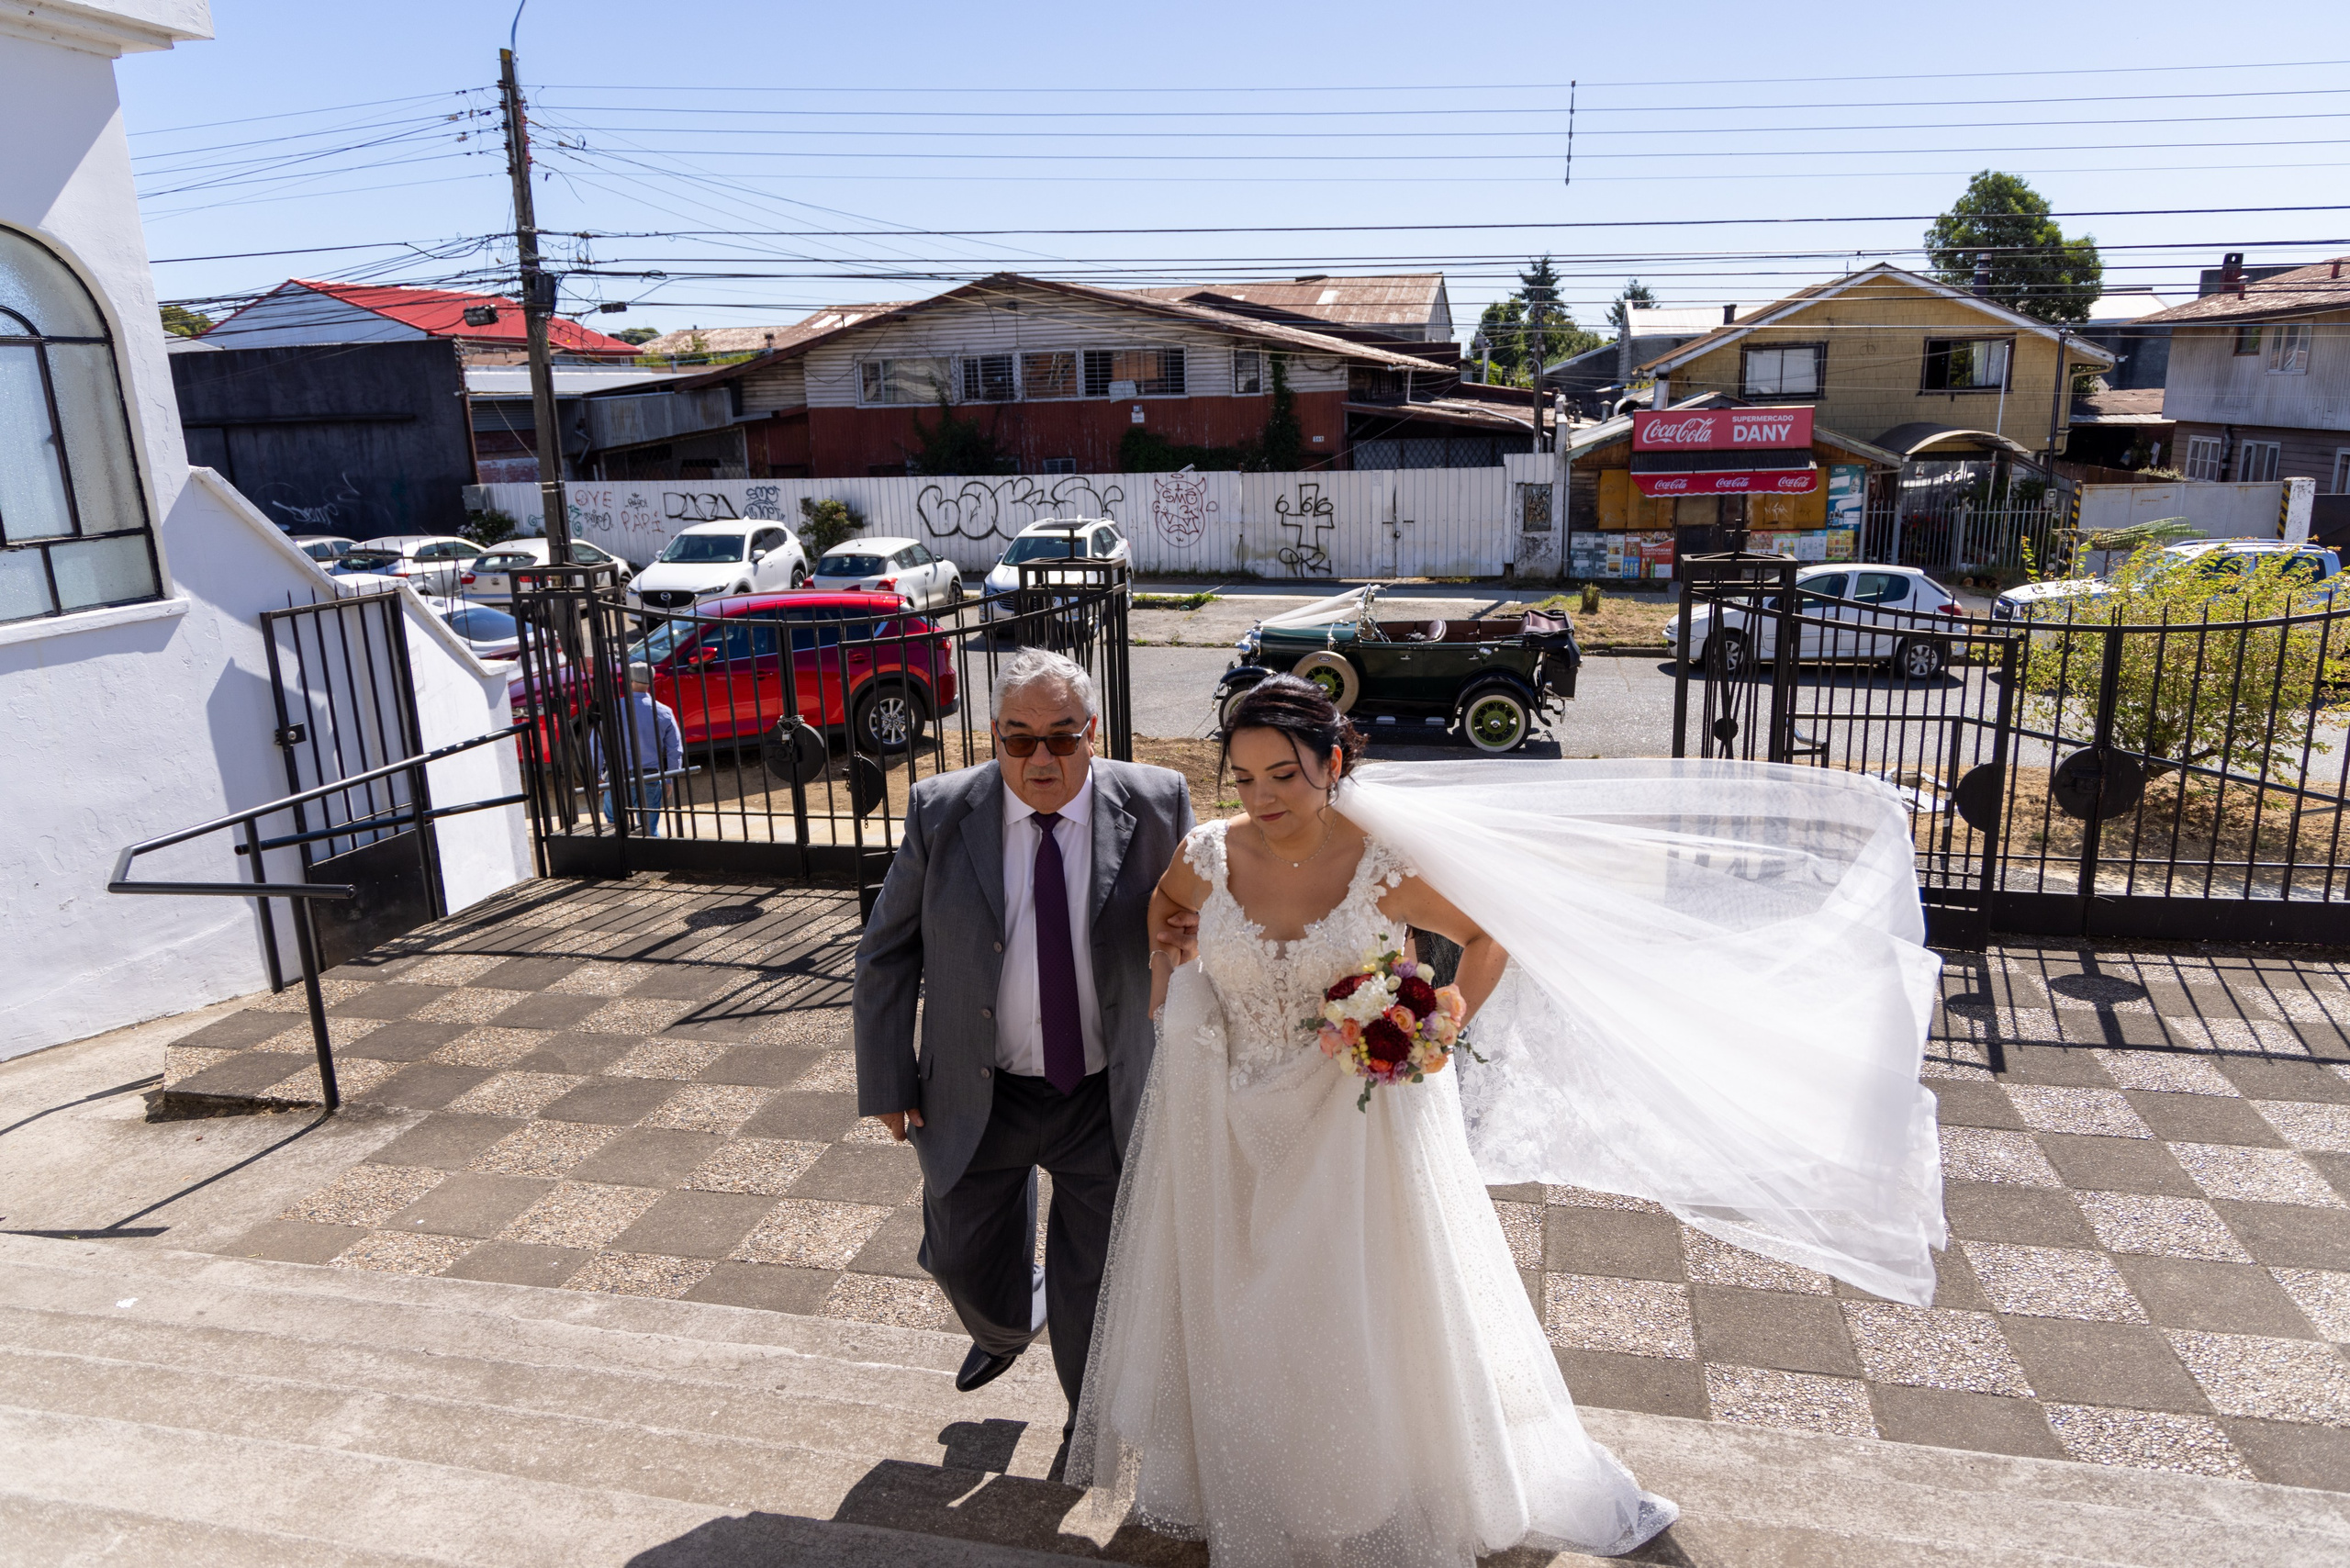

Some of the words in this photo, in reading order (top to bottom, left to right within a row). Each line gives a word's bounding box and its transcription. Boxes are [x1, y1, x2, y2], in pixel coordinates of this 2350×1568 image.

[1731, 414, 1795, 422] SUPERMERCADO
[1642, 417, 1717, 443] Coca-Cola
[1732, 423, 1792, 442] DANY
[574, 489, 612, 509] OYE
